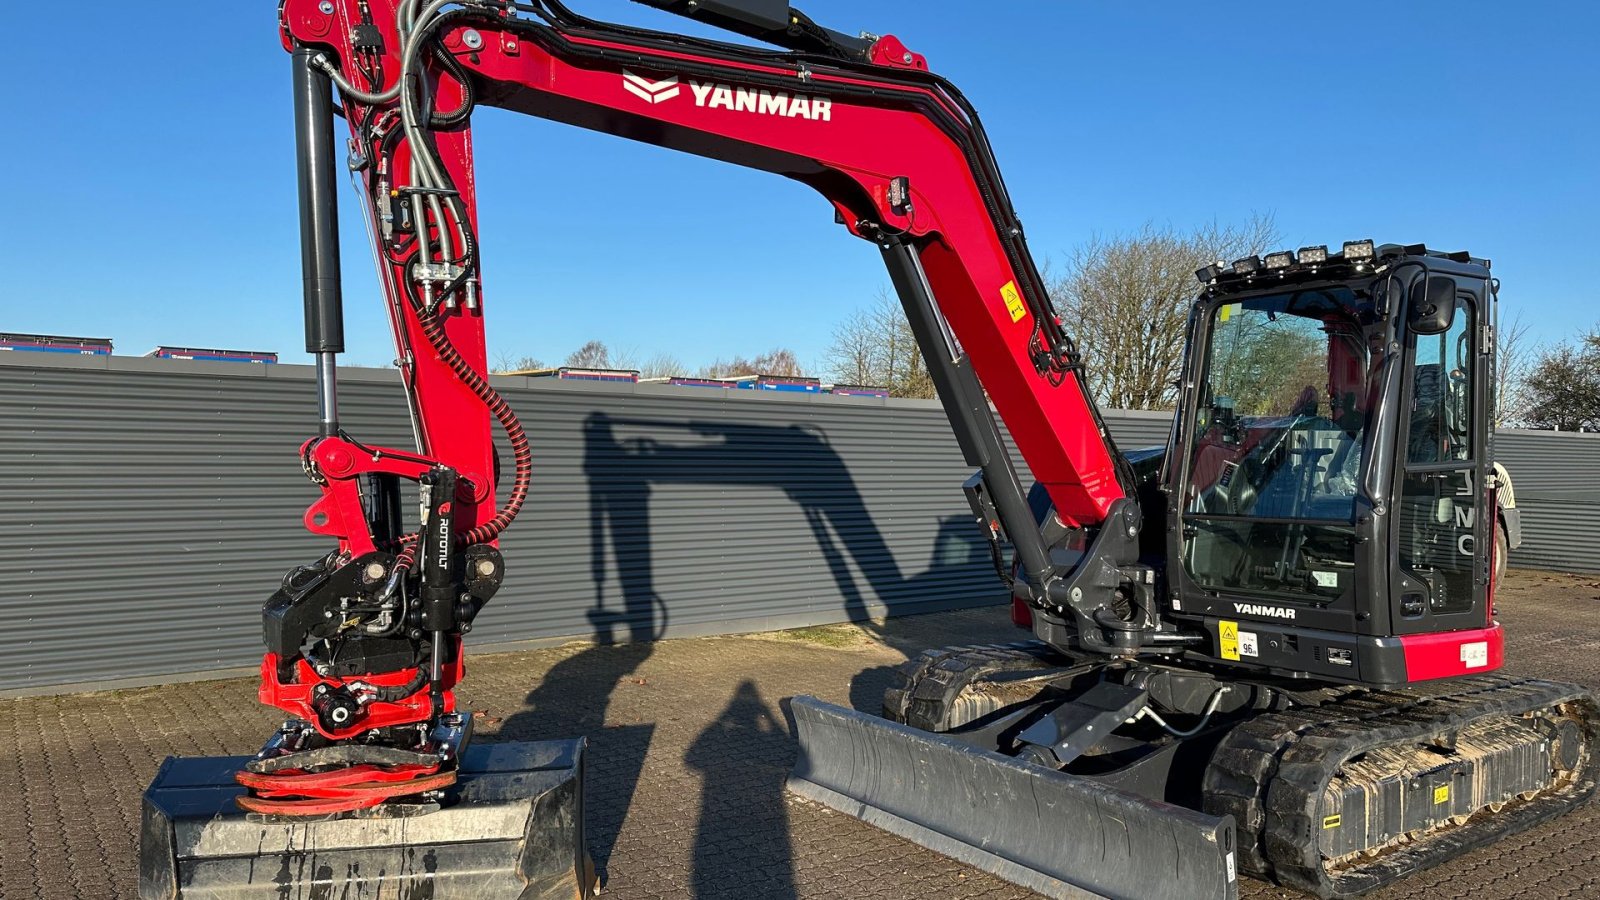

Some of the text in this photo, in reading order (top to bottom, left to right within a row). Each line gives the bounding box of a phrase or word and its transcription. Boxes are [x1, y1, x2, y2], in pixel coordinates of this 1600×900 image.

[688, 79, 832, 121] YANMAR
[438, 518, 449, 570] ROTOTILT
[1233, 602, 1296, 620] YANMAR
[1242, 643, 1253, 655] 96
